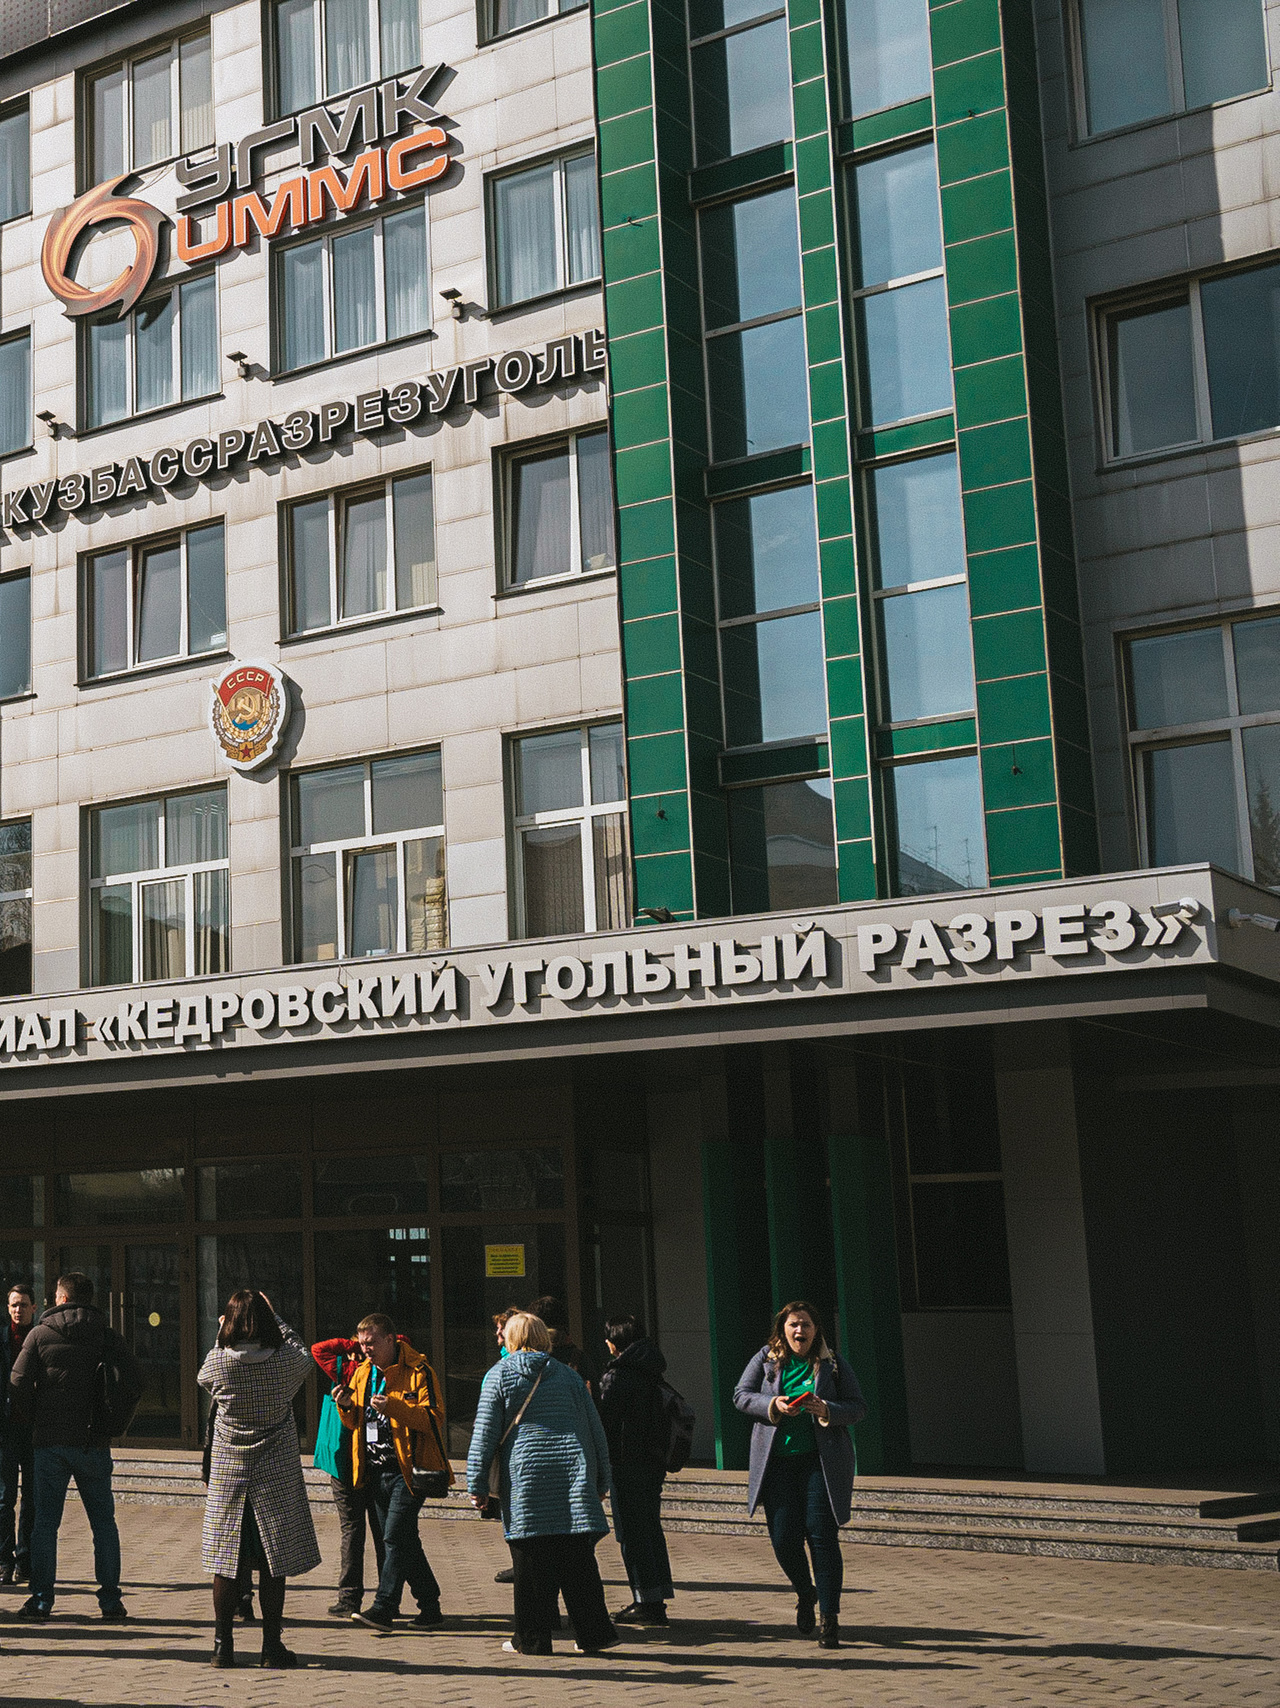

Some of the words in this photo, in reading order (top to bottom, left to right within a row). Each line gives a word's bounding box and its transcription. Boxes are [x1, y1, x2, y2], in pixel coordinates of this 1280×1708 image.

[176, 63, 447, 213] УГМК
[177, 127, 451, 264] UMMC
[2, 328, 606, 528] КУЗБАССРАЗРЕЗУГОЛЬ
[226, 671, 265, 689] СССР
[92, 960, 457, 1044] «КЕДРОВСКИЙ
[478, 922, 828, 1007] УГОЛЬНЫЙ
[857, 899, 1183, 973] РАЗРЕЗ»
